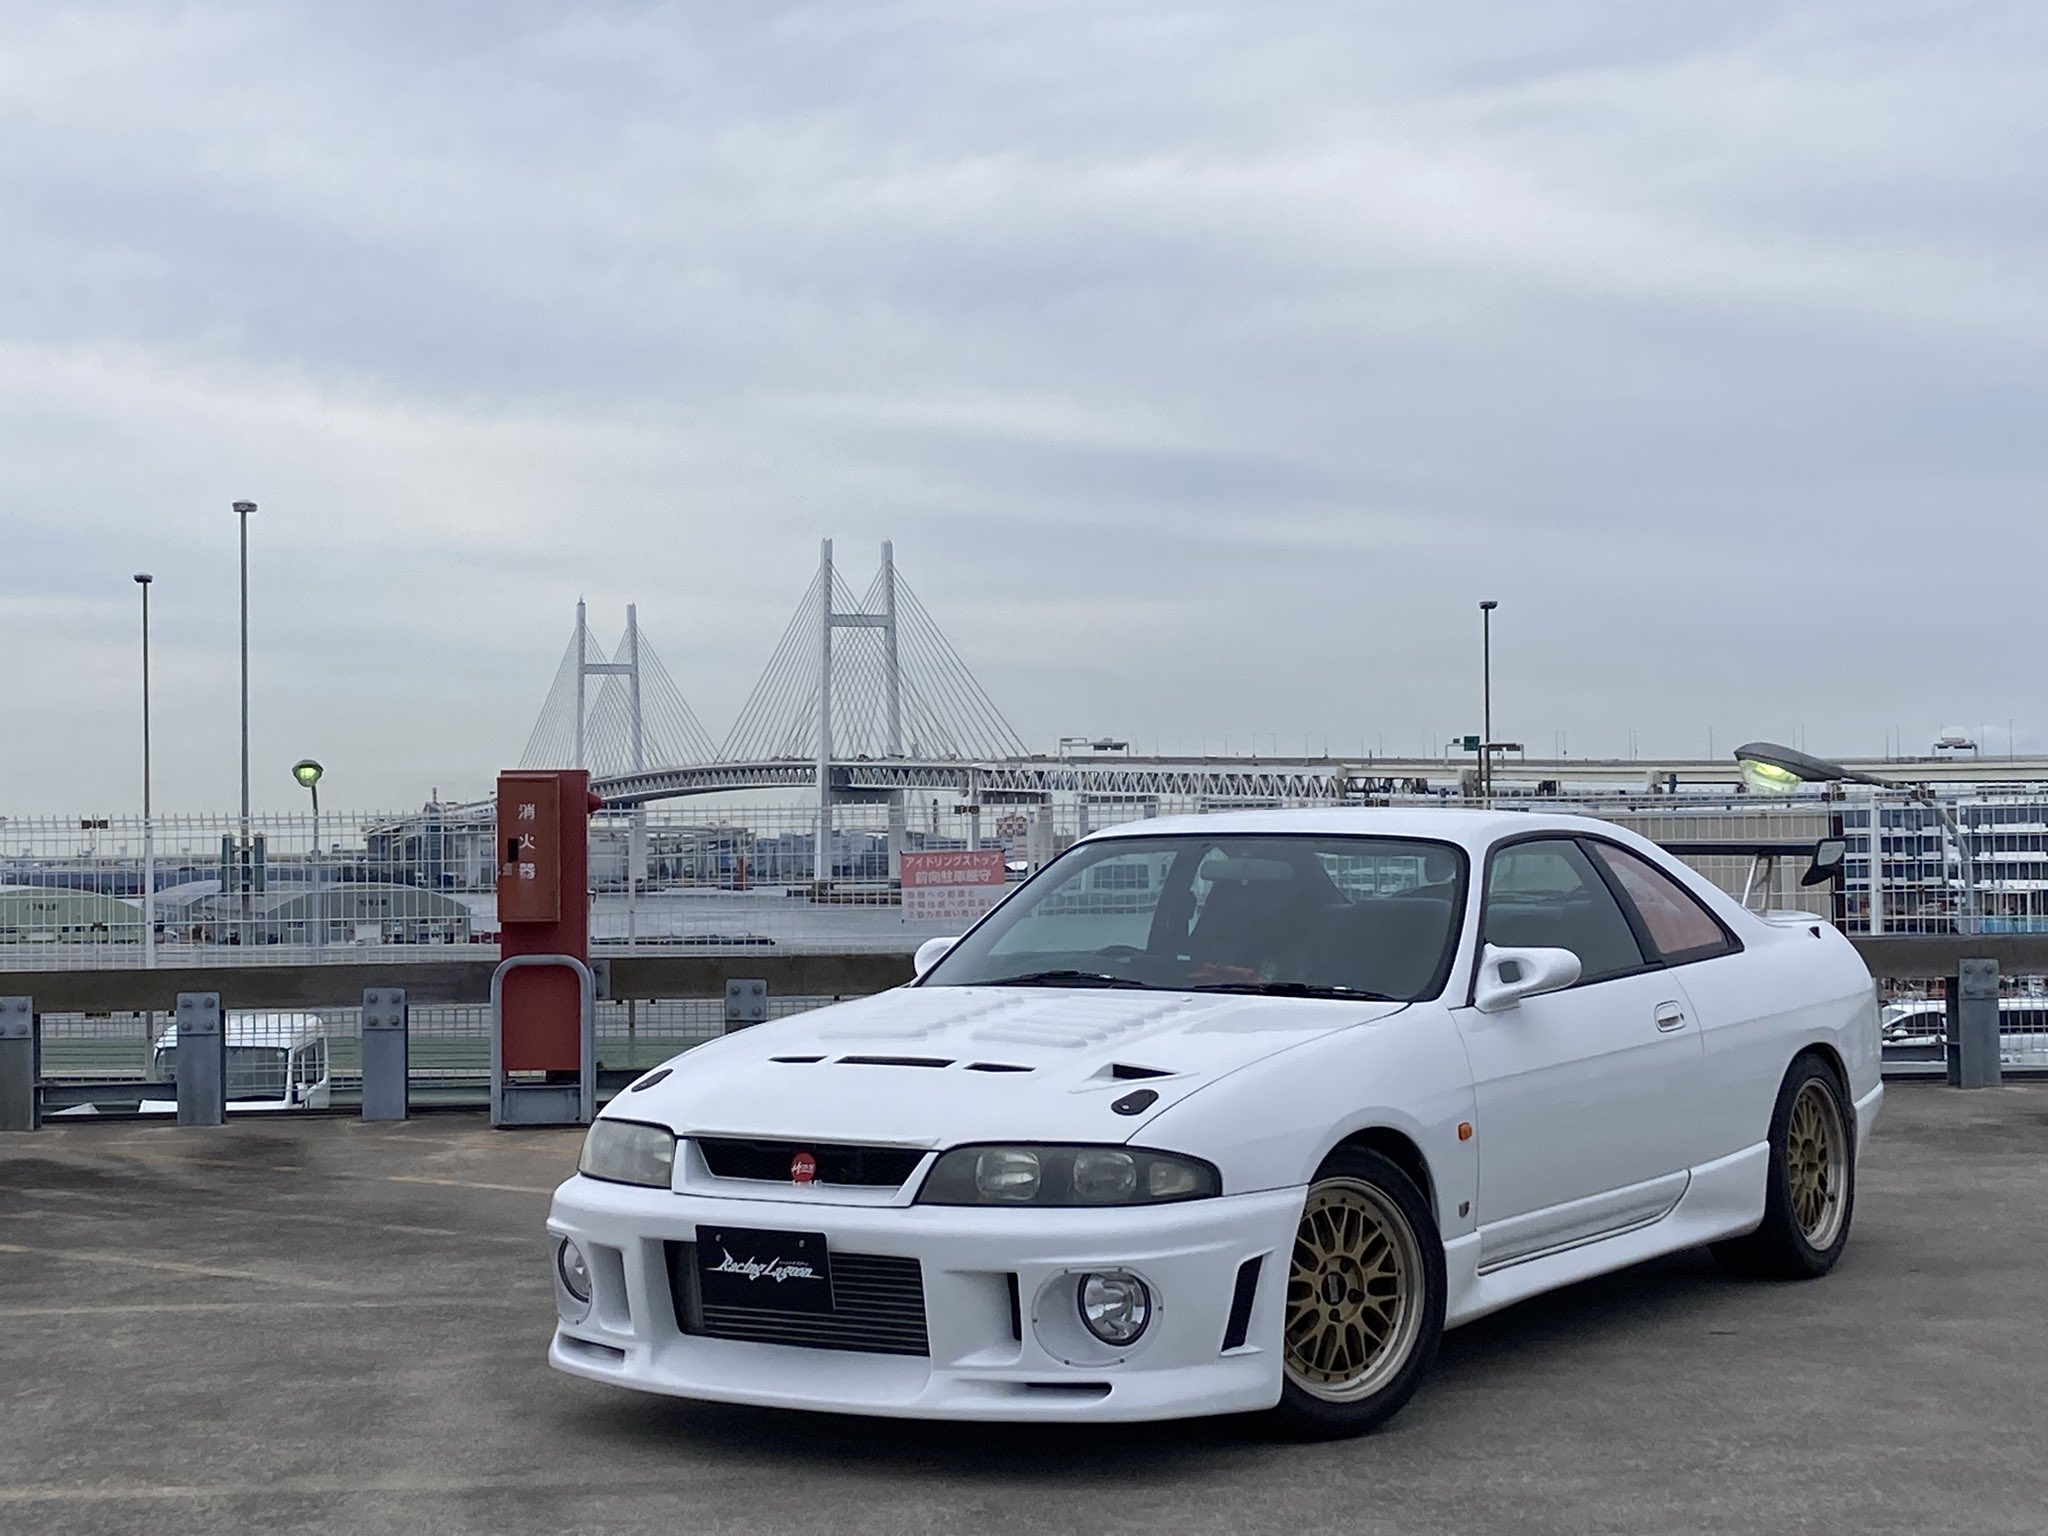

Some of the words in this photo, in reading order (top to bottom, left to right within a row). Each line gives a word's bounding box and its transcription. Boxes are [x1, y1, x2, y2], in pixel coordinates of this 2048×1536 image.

[518, 803, 536, 879] 消火器
[905, 854, 1000, 868] アイドリングストップ
[708, 1247, 767, 1281] Racing
[761, 1256, 821, 1283] Lagoon
